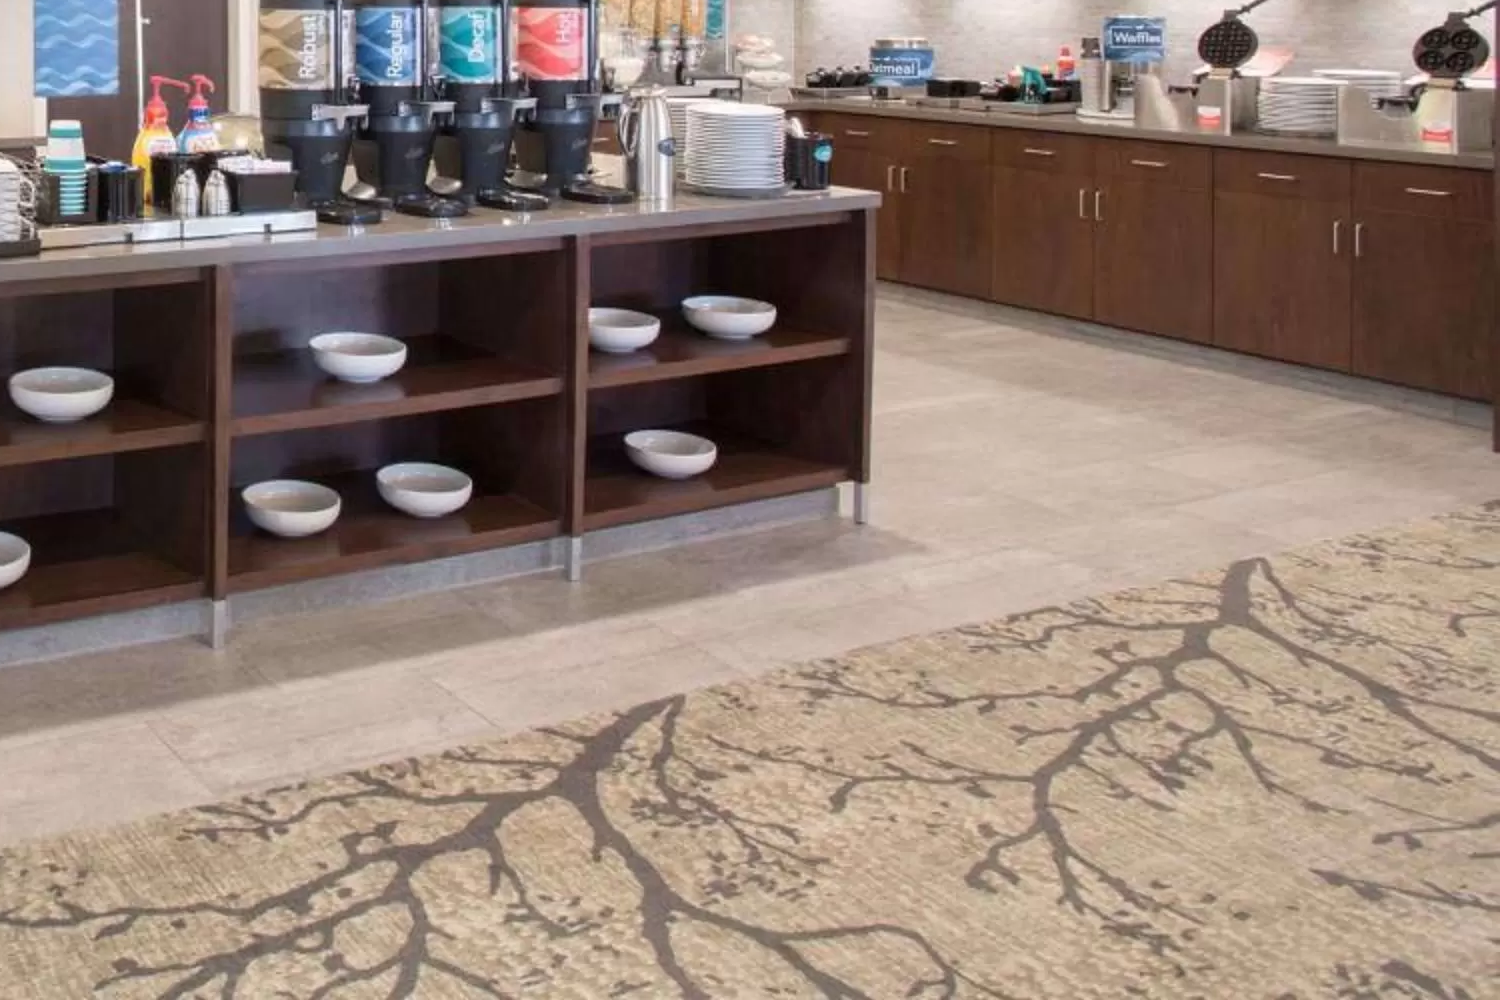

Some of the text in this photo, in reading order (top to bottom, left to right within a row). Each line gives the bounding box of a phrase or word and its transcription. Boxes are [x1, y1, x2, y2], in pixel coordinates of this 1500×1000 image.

[299, 13, 317, 79] Robust
[386, 11, 408, 77] Regular
[467, 10, 485, 62] Decaf
[556, 12, 571, 43] Hot
[1113, 31, 1161, 44] Waffles
